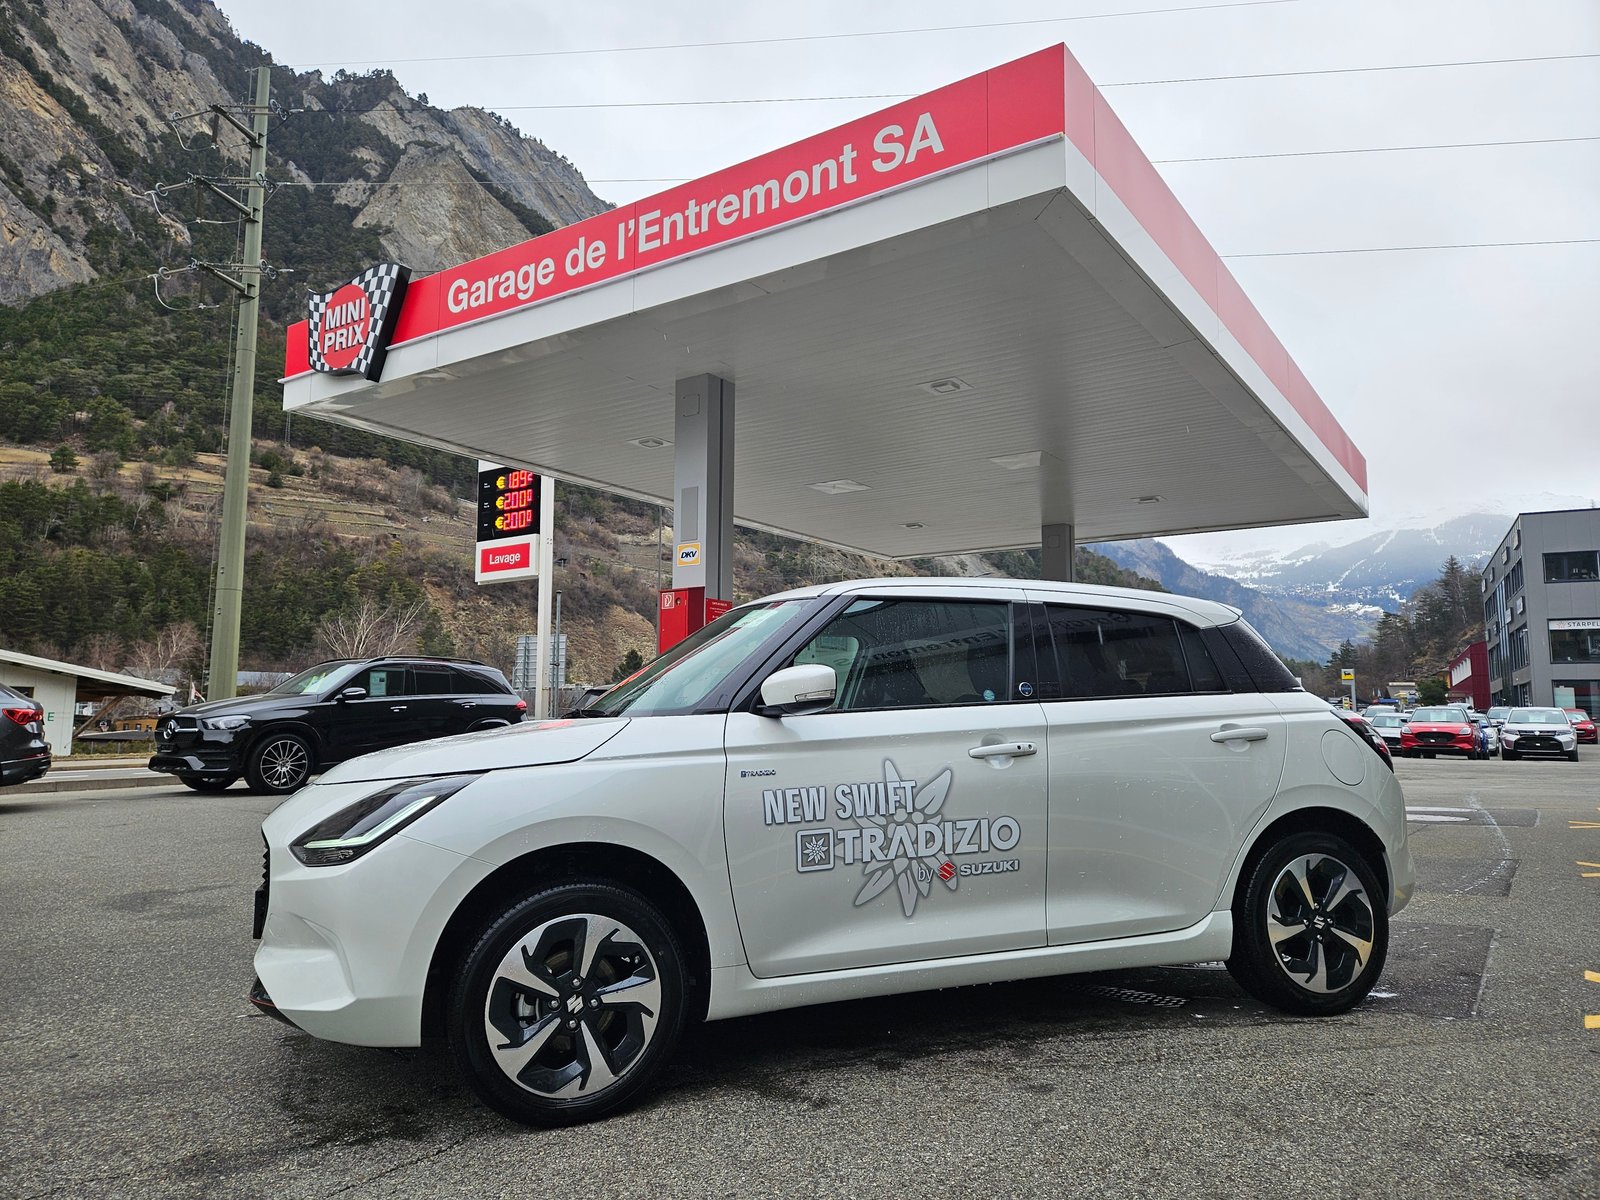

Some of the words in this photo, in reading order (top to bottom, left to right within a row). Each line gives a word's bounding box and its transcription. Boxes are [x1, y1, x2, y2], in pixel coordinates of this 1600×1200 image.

[447, 262, 556, 314] Garage
[565, 237, 606, 276] de
[871, 111, 945, 173] SA
[325, 297, 366, 331] MINI
[323, 322, 365, 355] PRIX
[489, 552, 521, 565] Lavage
[680, 550, 698, 558] DKV
[763, 787, 827, 825] NEW
[835, 780, 918, 820] SWIFT
[837, 815, 1022, 865] TRADIZIO
[917, 866, 934, 883] by
[959, 860, 1019, 877] SUZUKI
